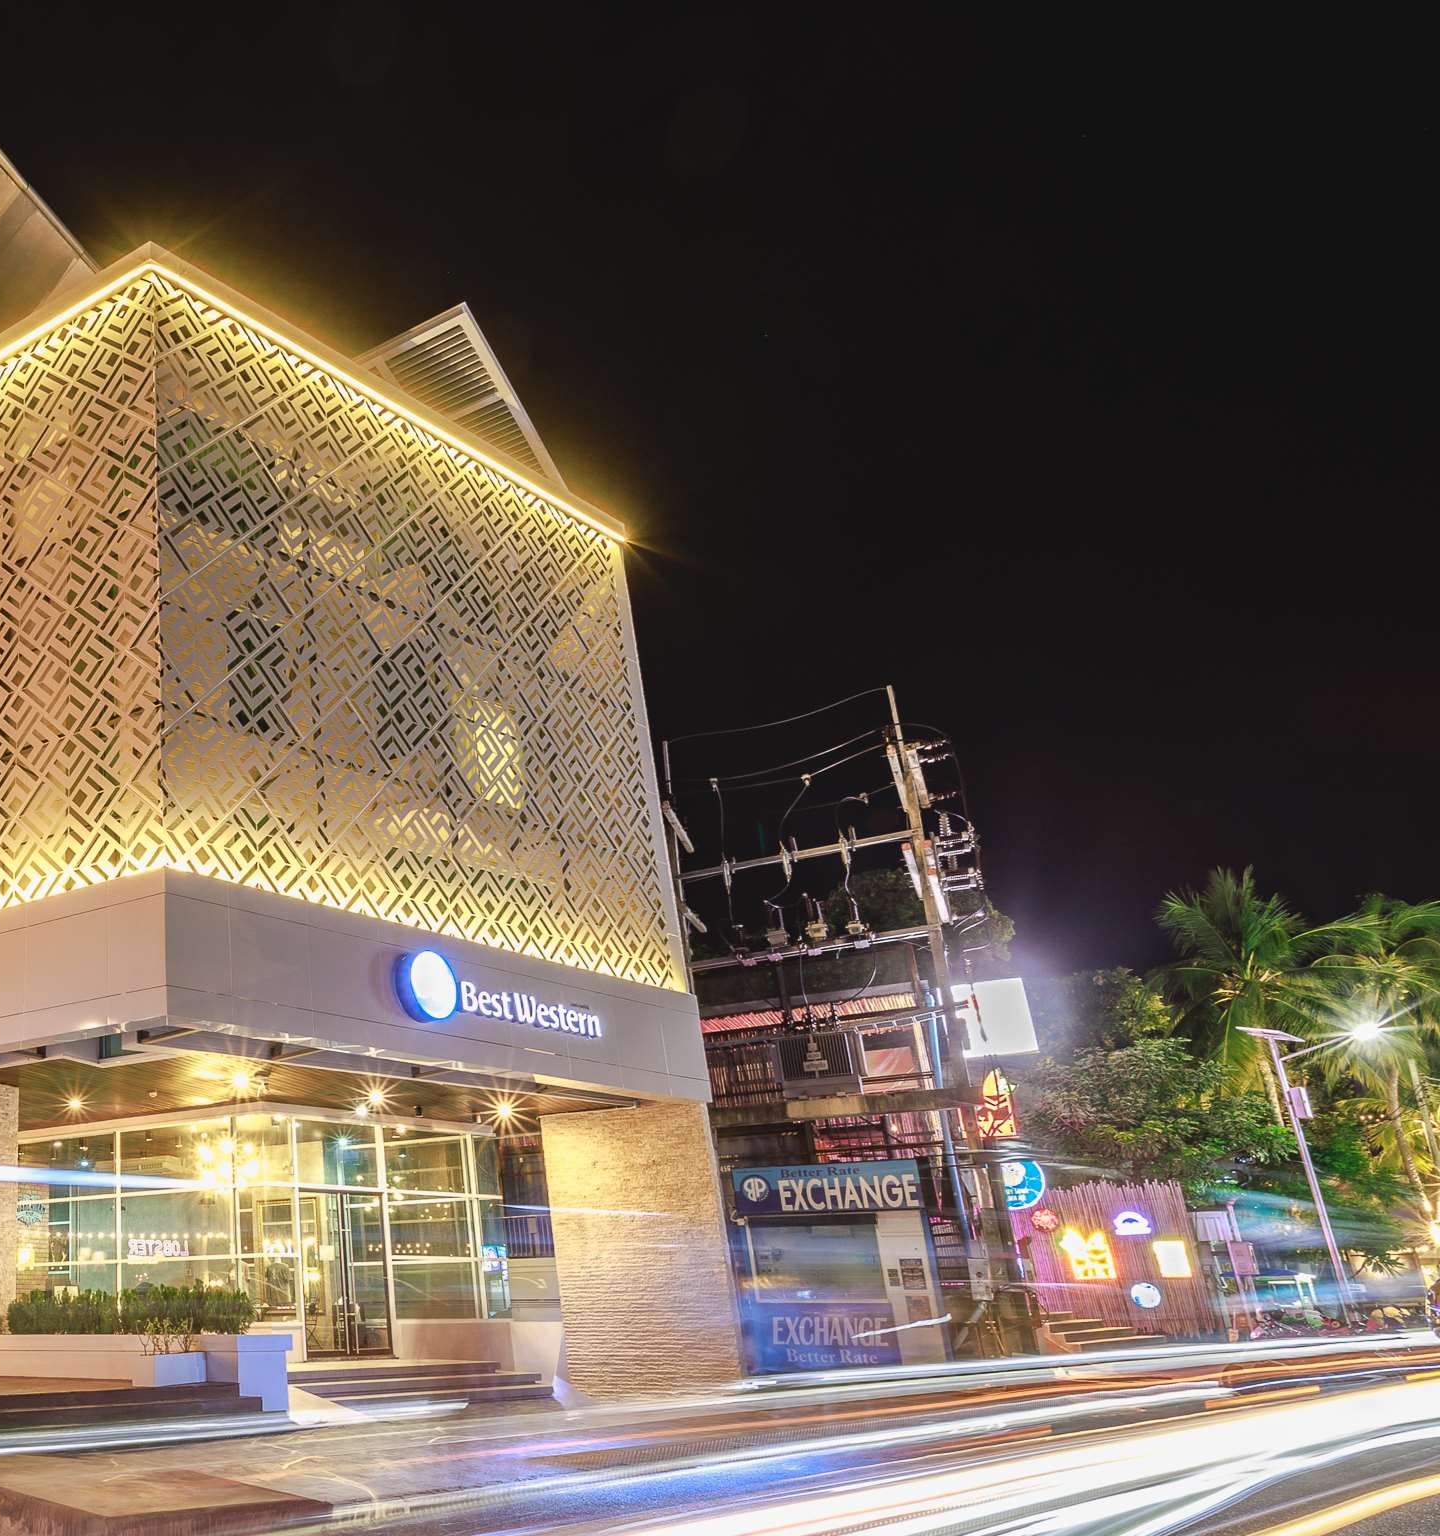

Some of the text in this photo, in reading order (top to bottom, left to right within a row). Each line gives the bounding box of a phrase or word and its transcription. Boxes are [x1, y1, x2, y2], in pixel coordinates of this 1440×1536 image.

[461, 981, 602, 1038] Best Western
[781, 1165, 860, 1179] Better Rate
[778, 1174, 920, 1212] EXCHANGE
[772, 1316, 889, 1347] EXCHANGE
[786, 1349, 879, 1364] Better Rate
